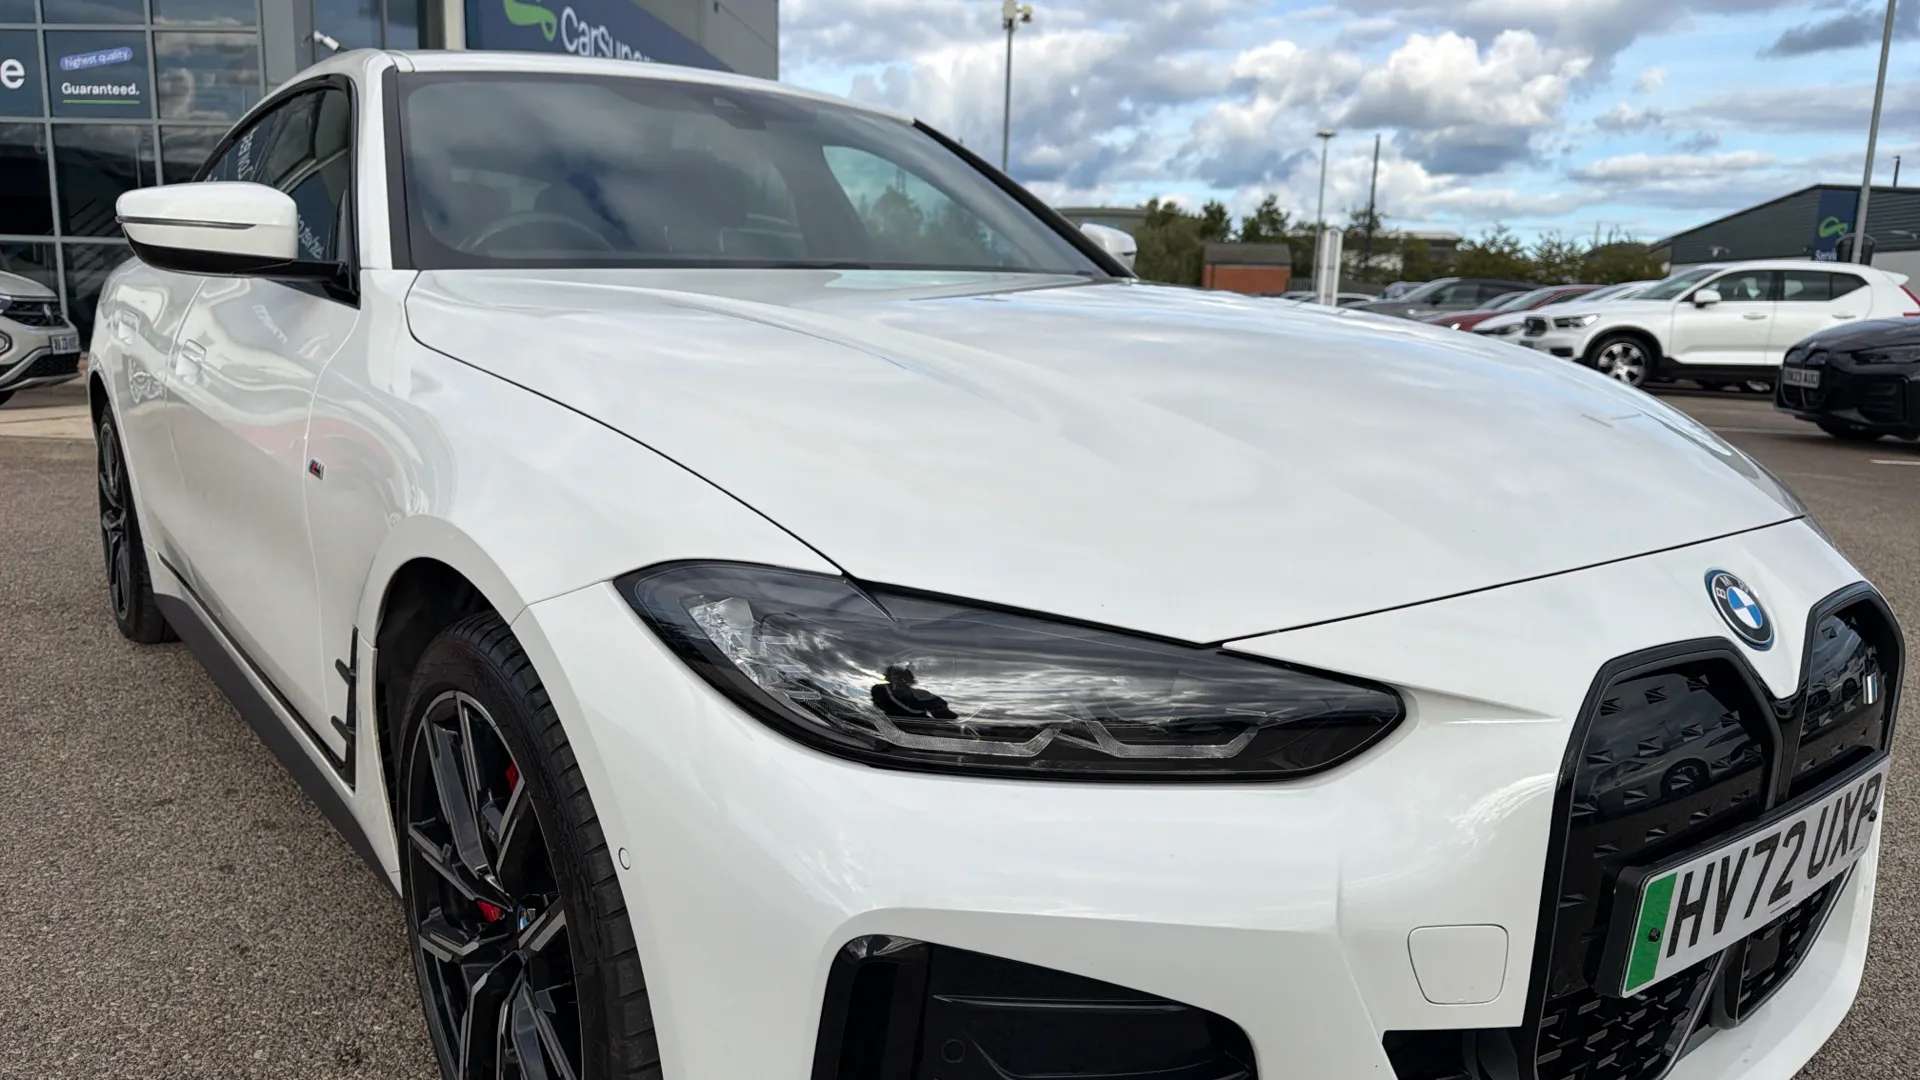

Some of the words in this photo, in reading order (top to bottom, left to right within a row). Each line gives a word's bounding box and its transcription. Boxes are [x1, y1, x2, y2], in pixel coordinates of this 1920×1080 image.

[61, 82, 140, 95] Guaranteed.
[1666, 820, 1807, 958] HV72
[1807, 773, 1882, 879] UXP
